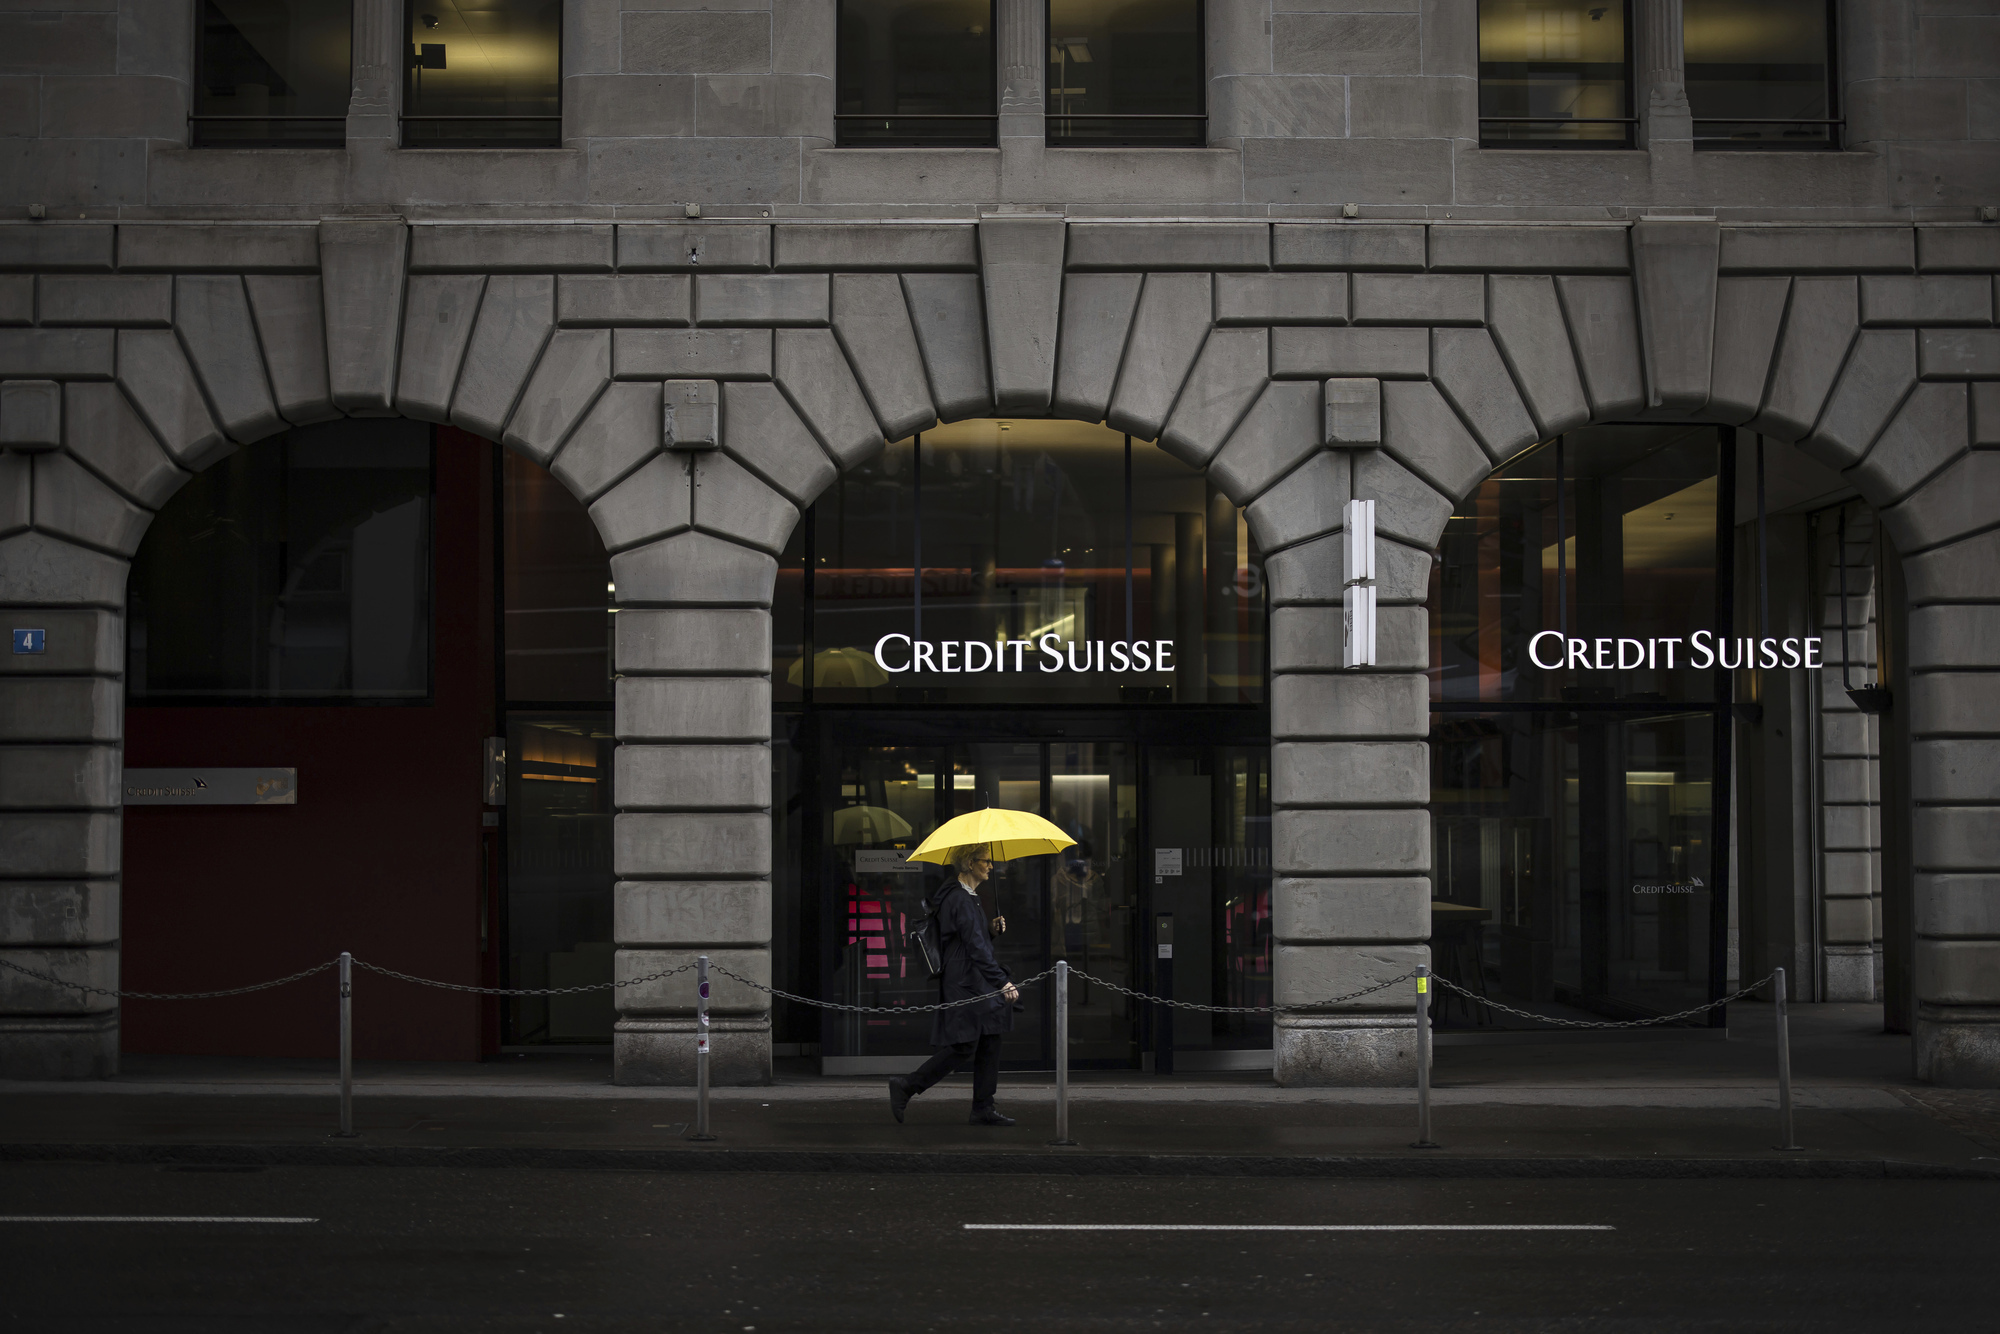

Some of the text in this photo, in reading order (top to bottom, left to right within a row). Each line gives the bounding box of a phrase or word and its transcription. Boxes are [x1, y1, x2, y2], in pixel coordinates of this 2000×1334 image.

[23, 632, 33, 650] 4
[1528, 630, 1824, 670] CREDIT SUISSE
[874, 633, 1176, 673] CREDIT SUISSE
[126, 785, 196, 797] CREDIT SUISSE
[1632, 884, 1694, 894] CREDIT SUISSE
